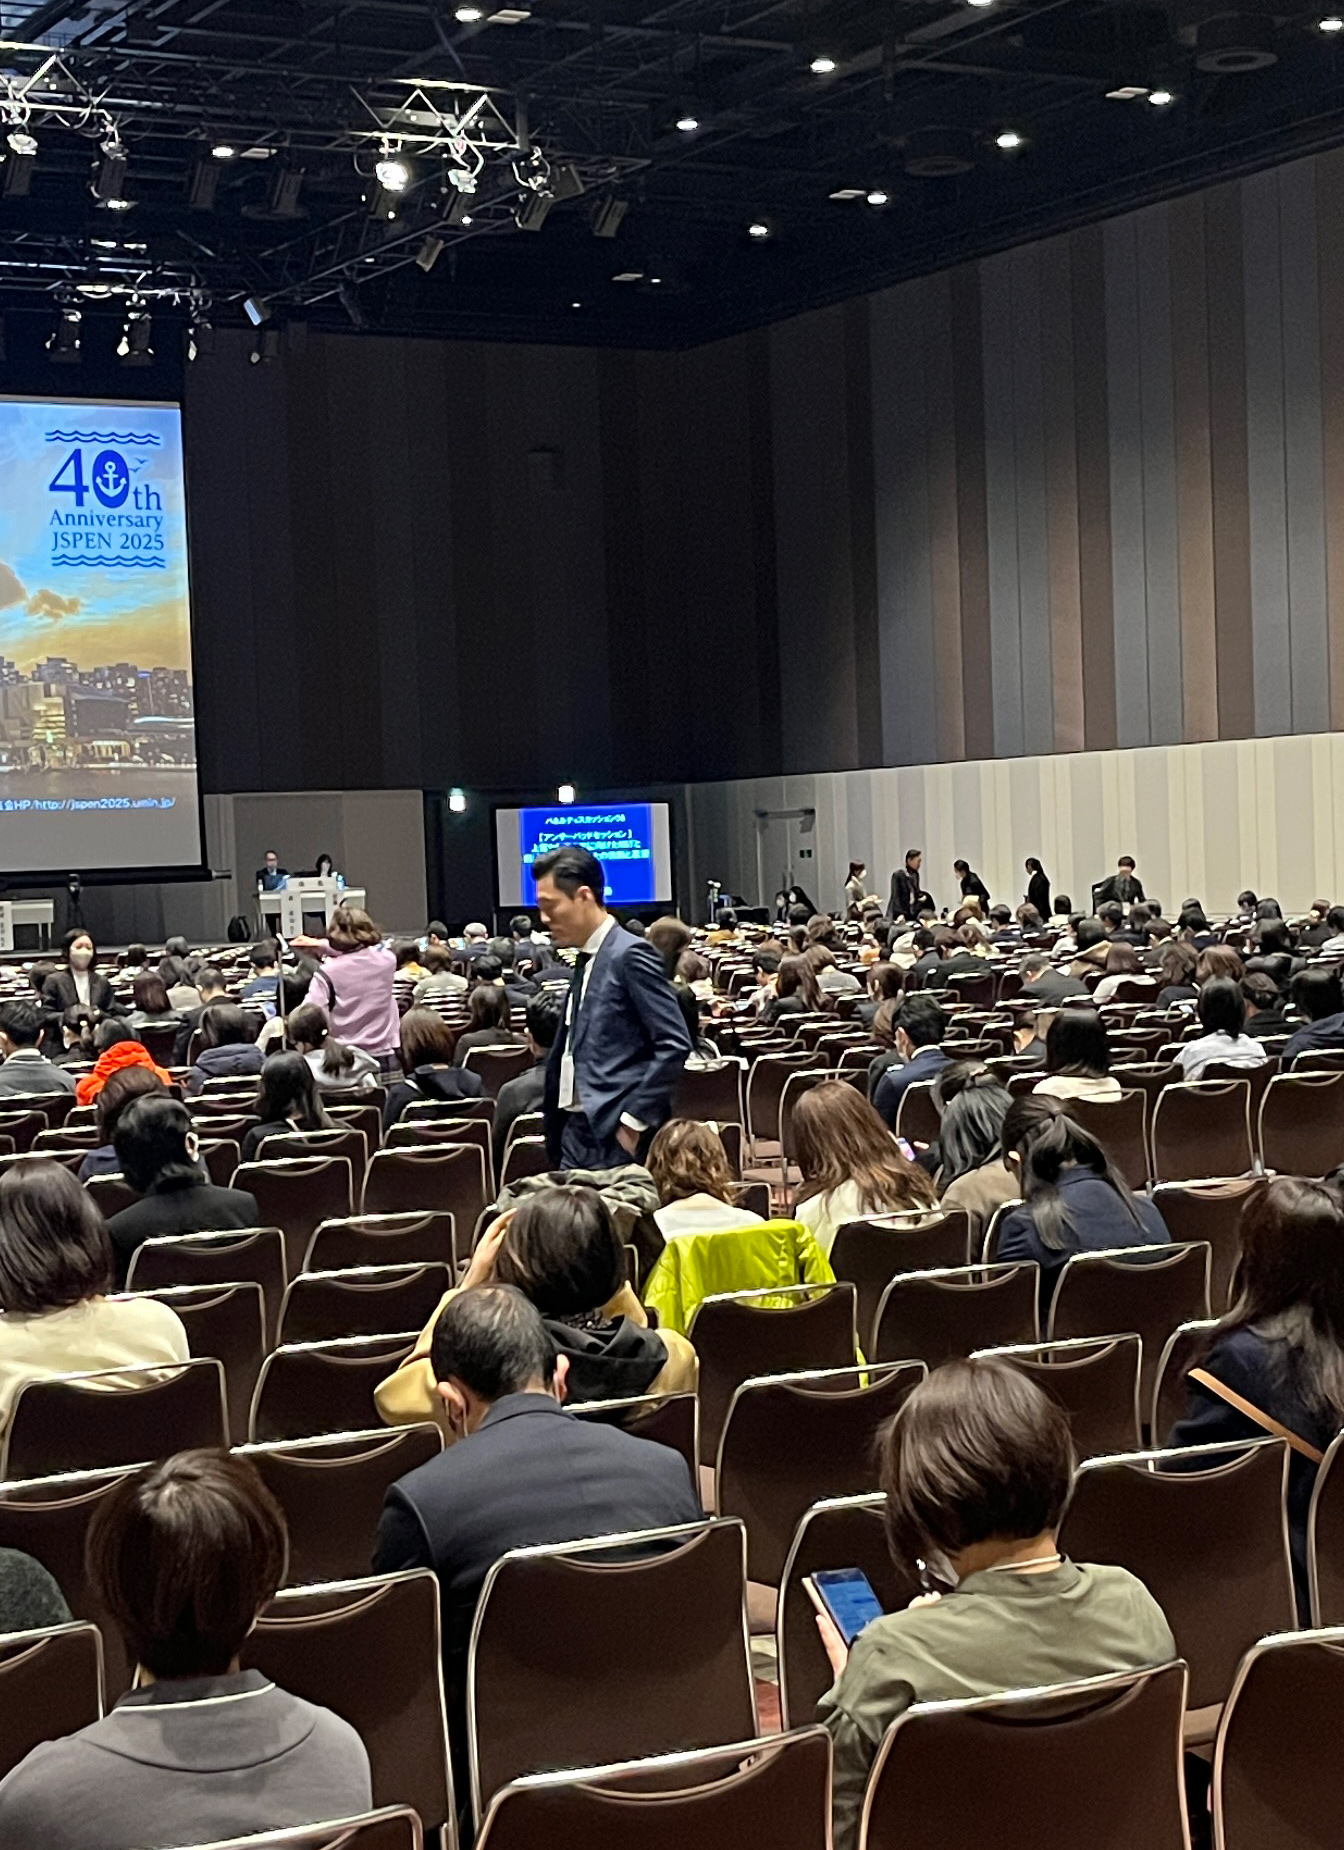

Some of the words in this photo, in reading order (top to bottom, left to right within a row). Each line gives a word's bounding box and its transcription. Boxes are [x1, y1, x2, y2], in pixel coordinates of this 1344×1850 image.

[49, 509, 164, 531] Anniversary
[51, 532, 112, 551] JSPEN
[120, 533, 164, 550] 2025
